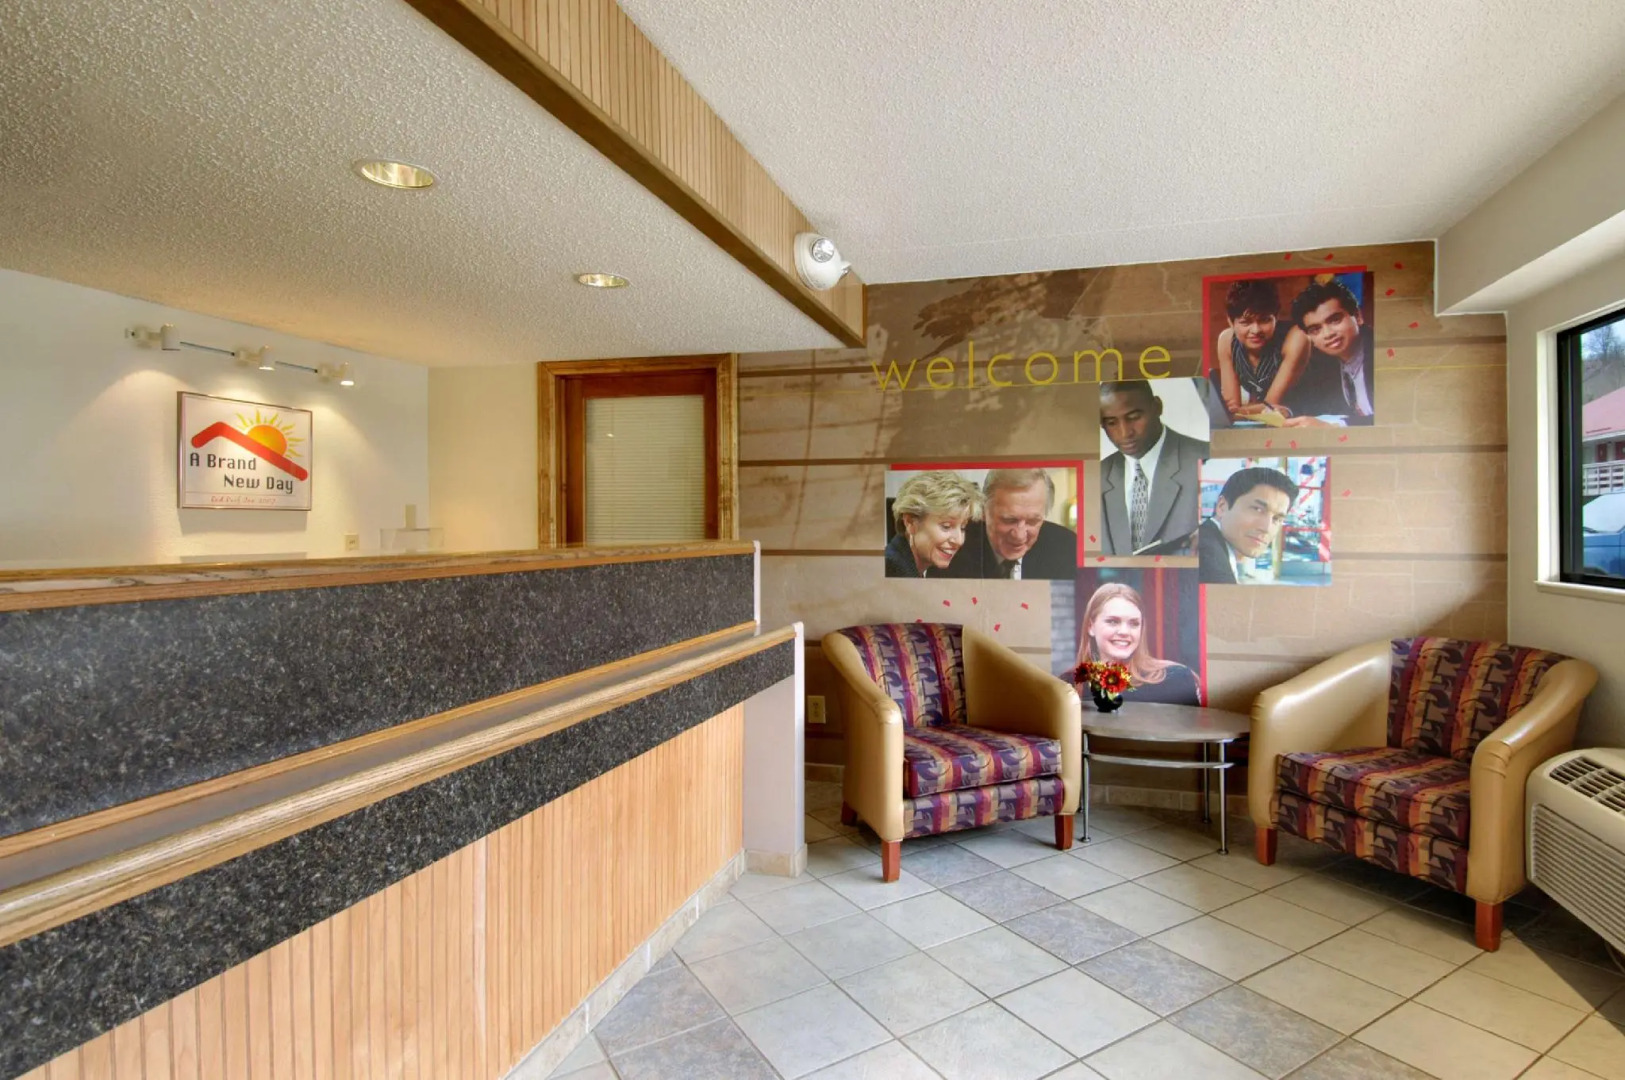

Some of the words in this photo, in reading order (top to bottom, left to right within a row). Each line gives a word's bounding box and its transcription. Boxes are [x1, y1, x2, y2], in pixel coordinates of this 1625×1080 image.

[871, 341, 1173, 391] welcome
[190, 452, 200, 467] A
[207, 453, 257, 471] Brand
[224, 474, 260, 489] New
[266, 476, 294, 494] Day
